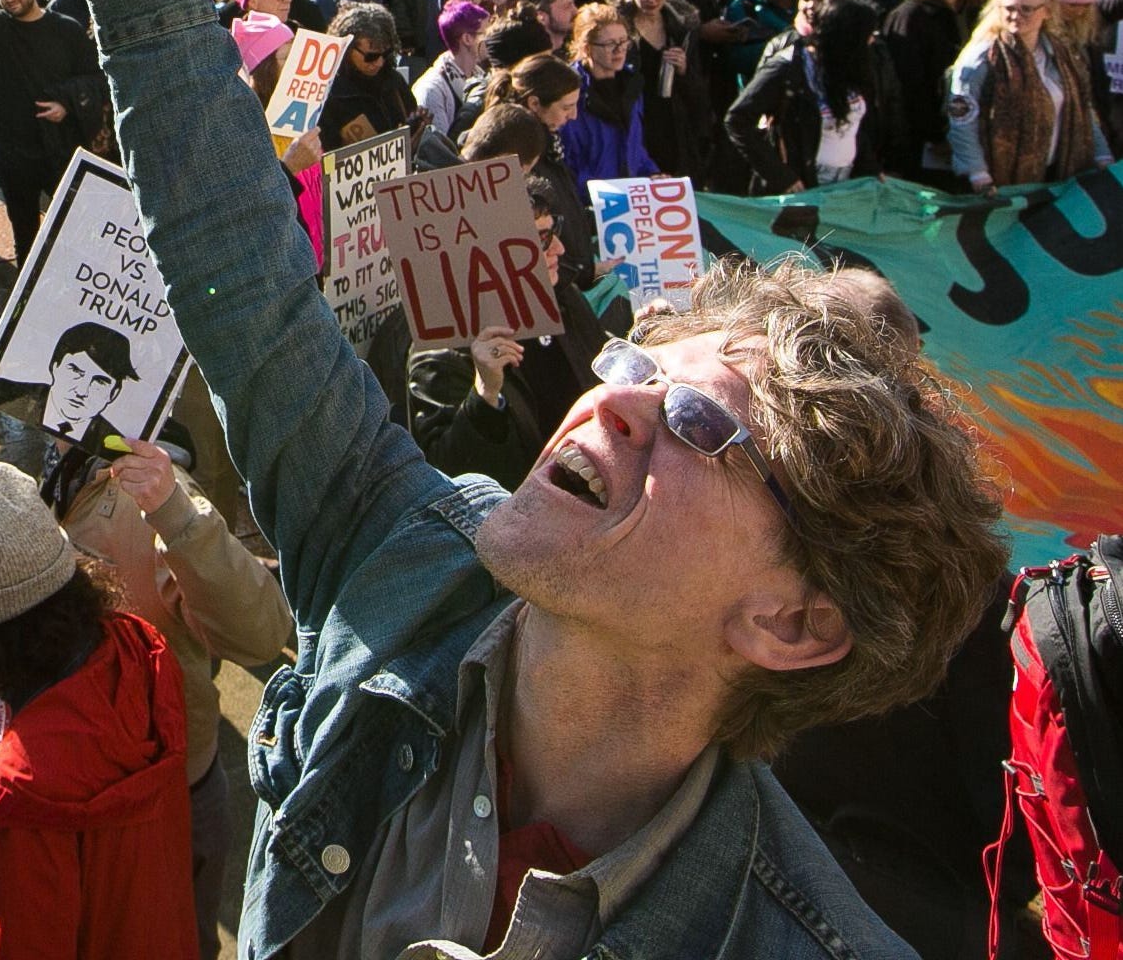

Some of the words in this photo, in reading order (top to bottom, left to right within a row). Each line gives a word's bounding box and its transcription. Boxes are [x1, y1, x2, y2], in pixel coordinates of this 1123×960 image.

[335, 154, 363, 185] TOO
[369, 137, 405, 172] MUCH
[378, 162, 511, 221] TRUMP
[346, 203, 378, 228] WITH
[413, 223, 442, 252] IS
[455, 215, 479, 245] A
[629, 184, 655, 254] REPEAL
[76, 263, 171, 318] DONALD
[121, 255, 147, 284] VS.
[333, 277, 352, 298] TO
[355, 260, 376, 290] FIT
[400, 238, 560, 341] LIAR
[79, 288, 158, 335] TRUMP
[333, 294, 368, 324] THIS
